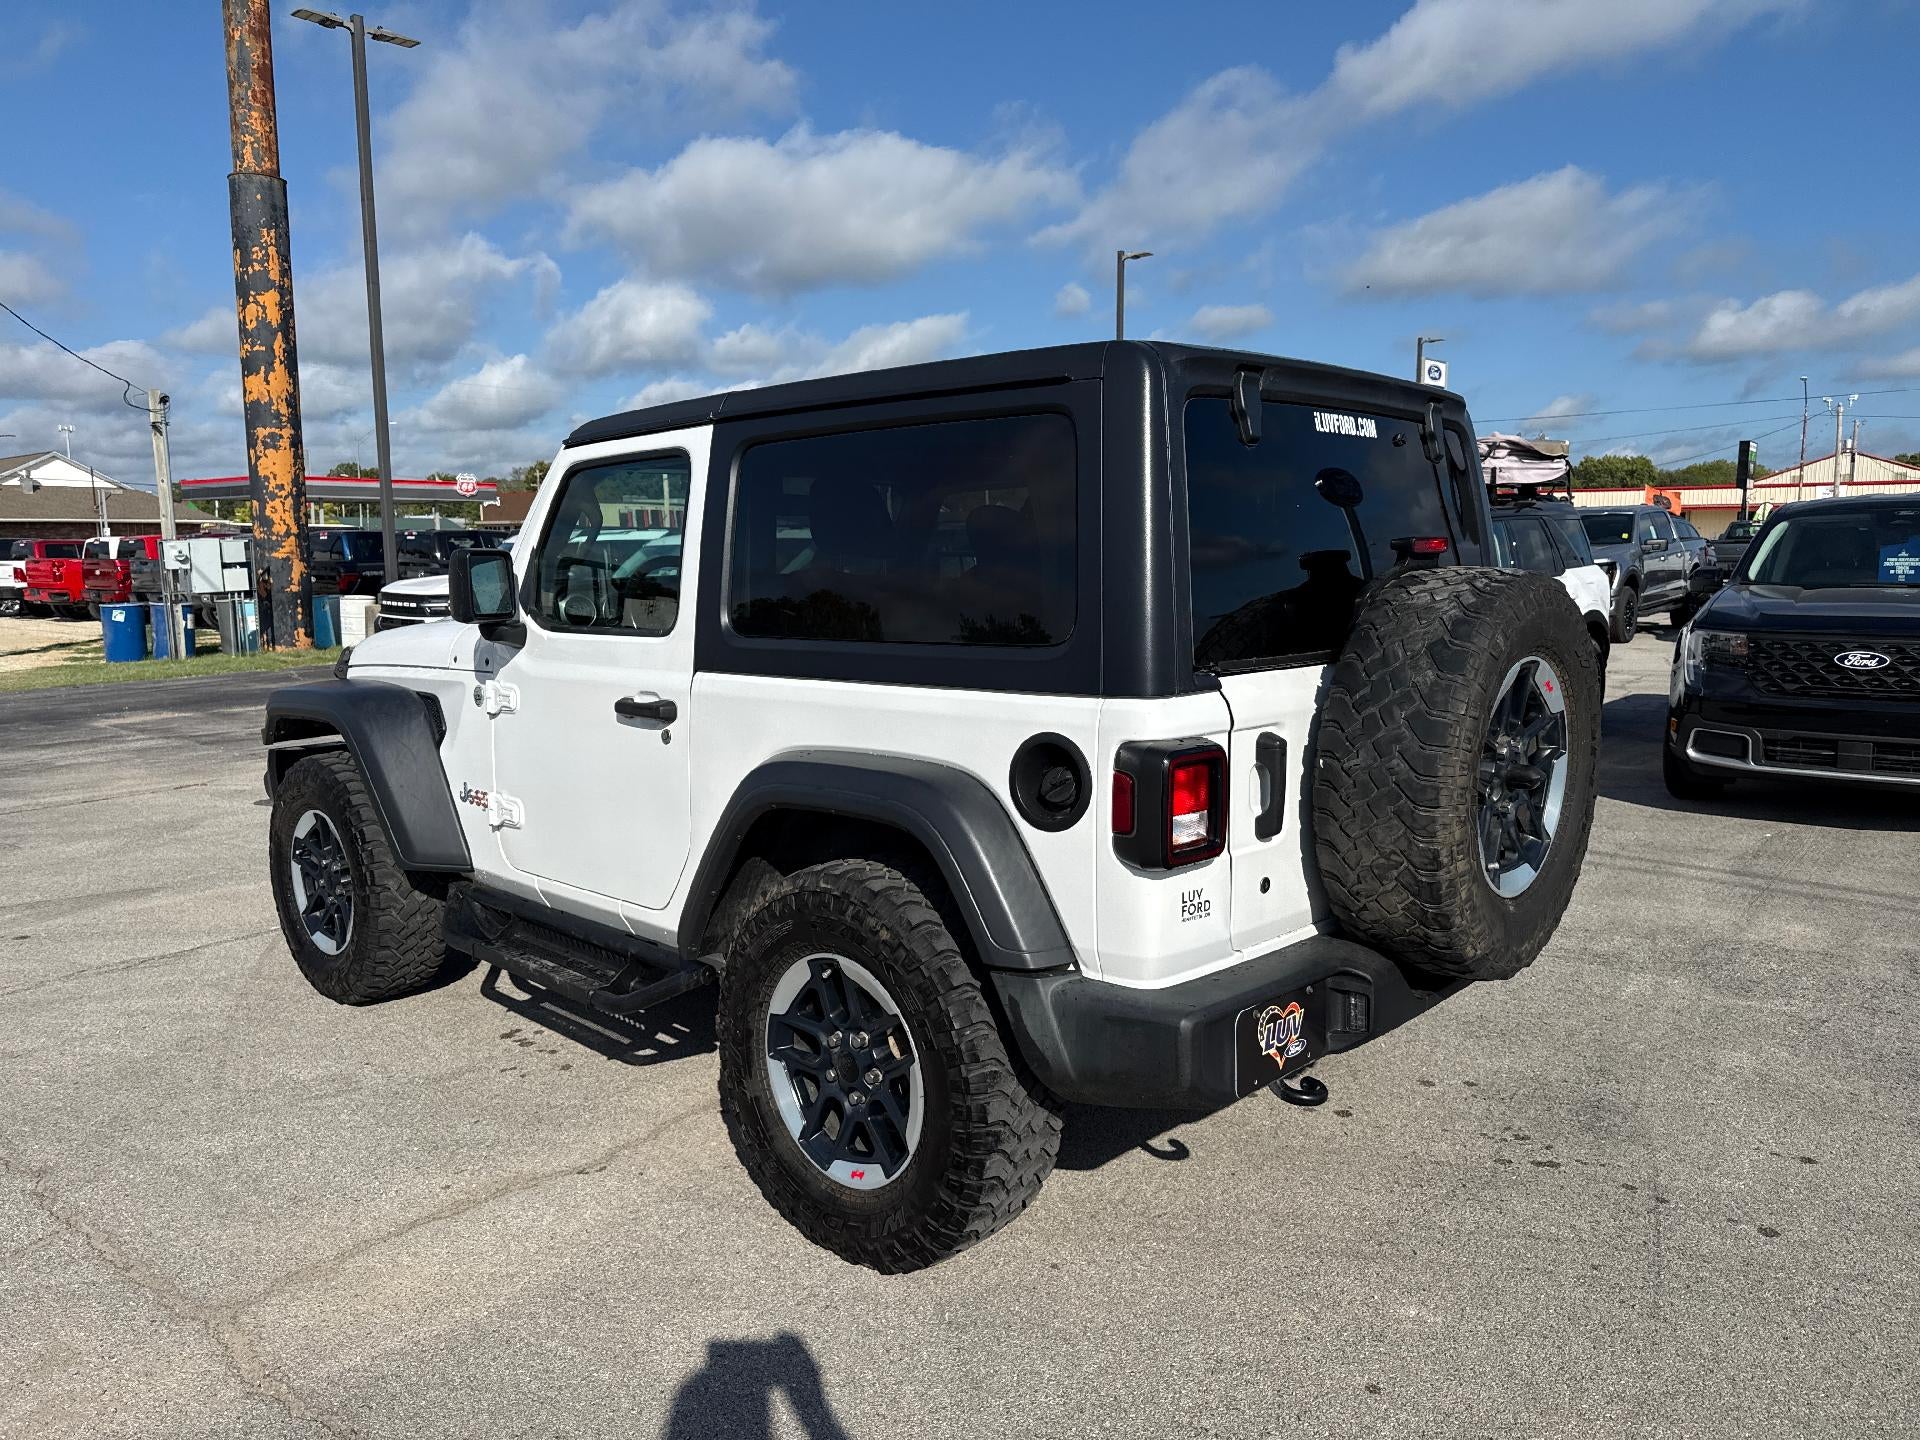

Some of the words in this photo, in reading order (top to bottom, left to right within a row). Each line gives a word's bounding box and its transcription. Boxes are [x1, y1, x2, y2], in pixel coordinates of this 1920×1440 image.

[1313, 411, 1377, 438] iLUVFORD.COM
[382, 600, 417, 608] BRONCO
[1844, 653, 1879, 666] Ford
[1181, 900, 1211, 917] FORD
[1262, 1008, 1304, 1055] LUV
[1287, 1040, 1304, 1056] Ford
